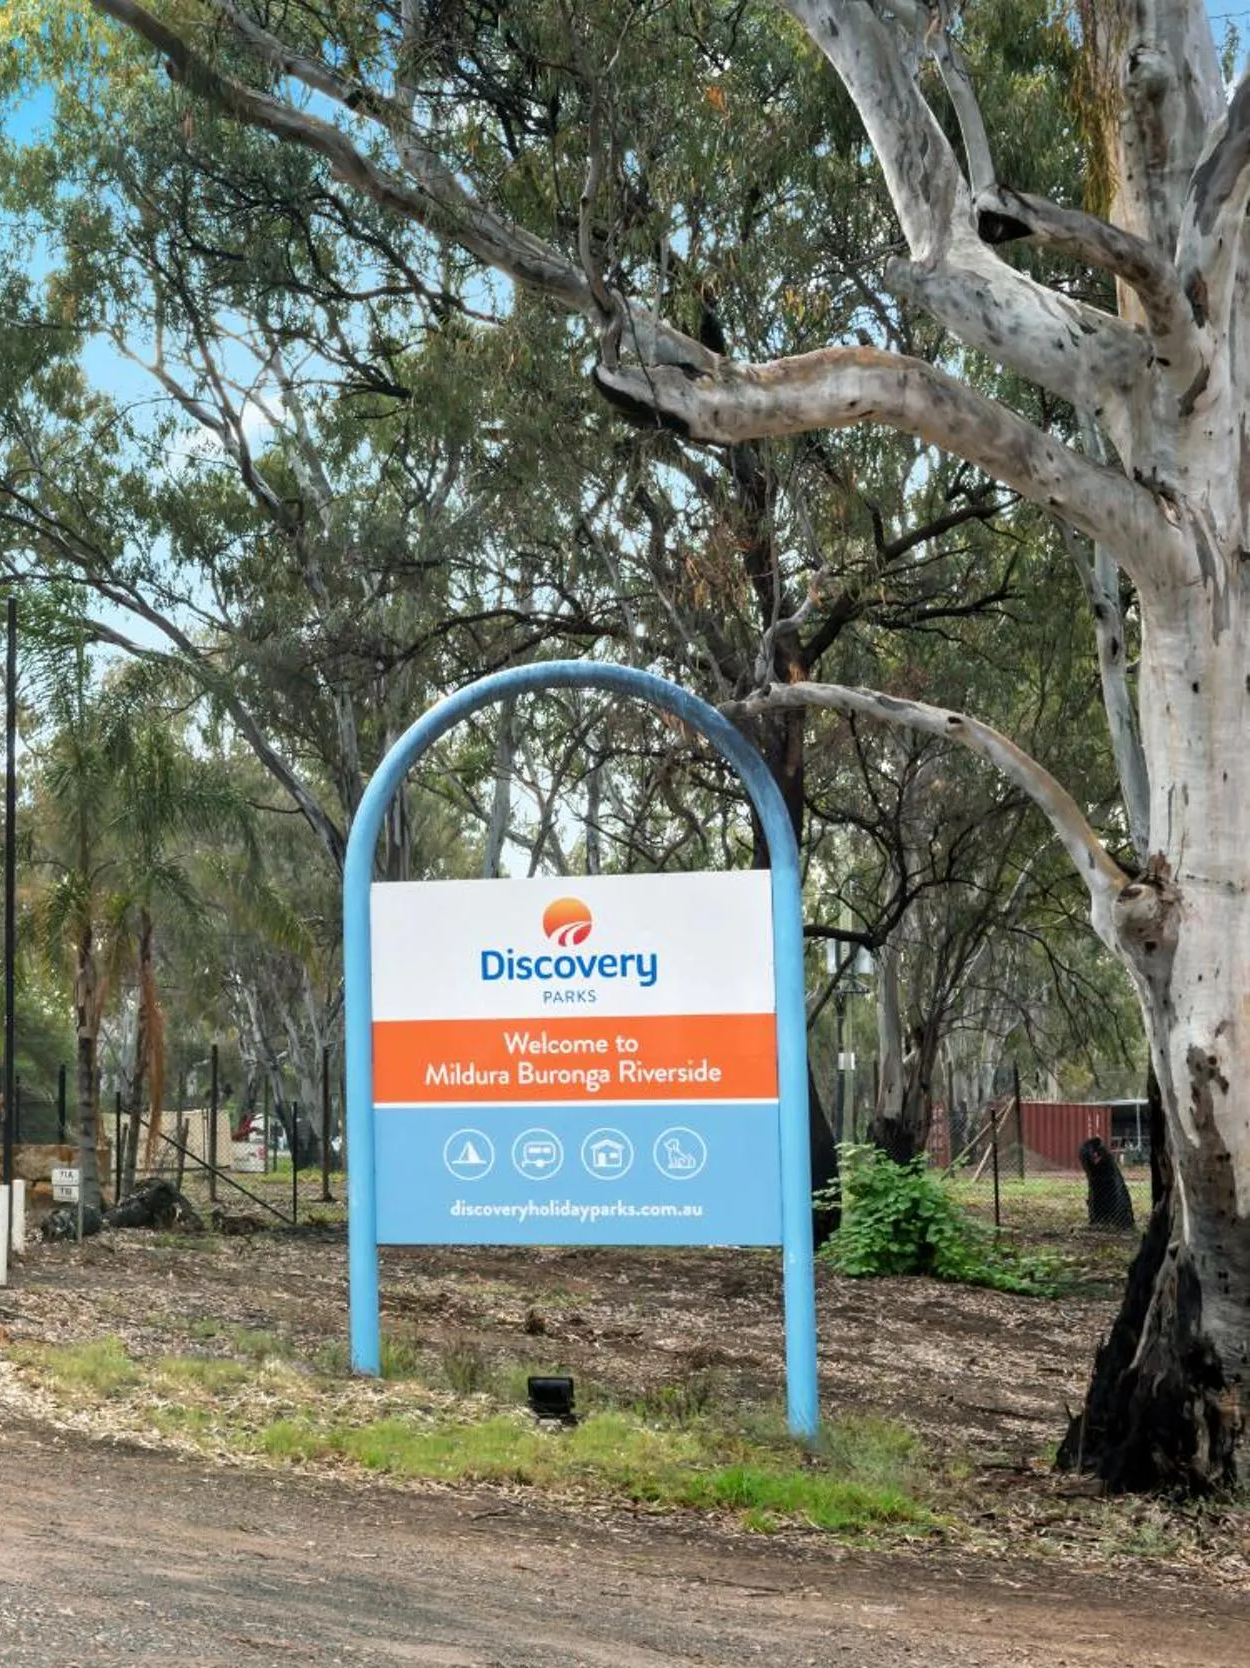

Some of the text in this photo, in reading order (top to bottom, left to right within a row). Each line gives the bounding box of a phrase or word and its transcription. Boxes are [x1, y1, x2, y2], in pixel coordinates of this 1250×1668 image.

[481, 949, 658, 987] Discovery
[543, 989, 597, 1003] PARKS
[504, 1032, 639, 1054] Welcome to
[425, 1060, 722, 1091] Mildura Buronga Riverside
[451, 1200, 702, 1221] discoveryholidayparks.com.au
